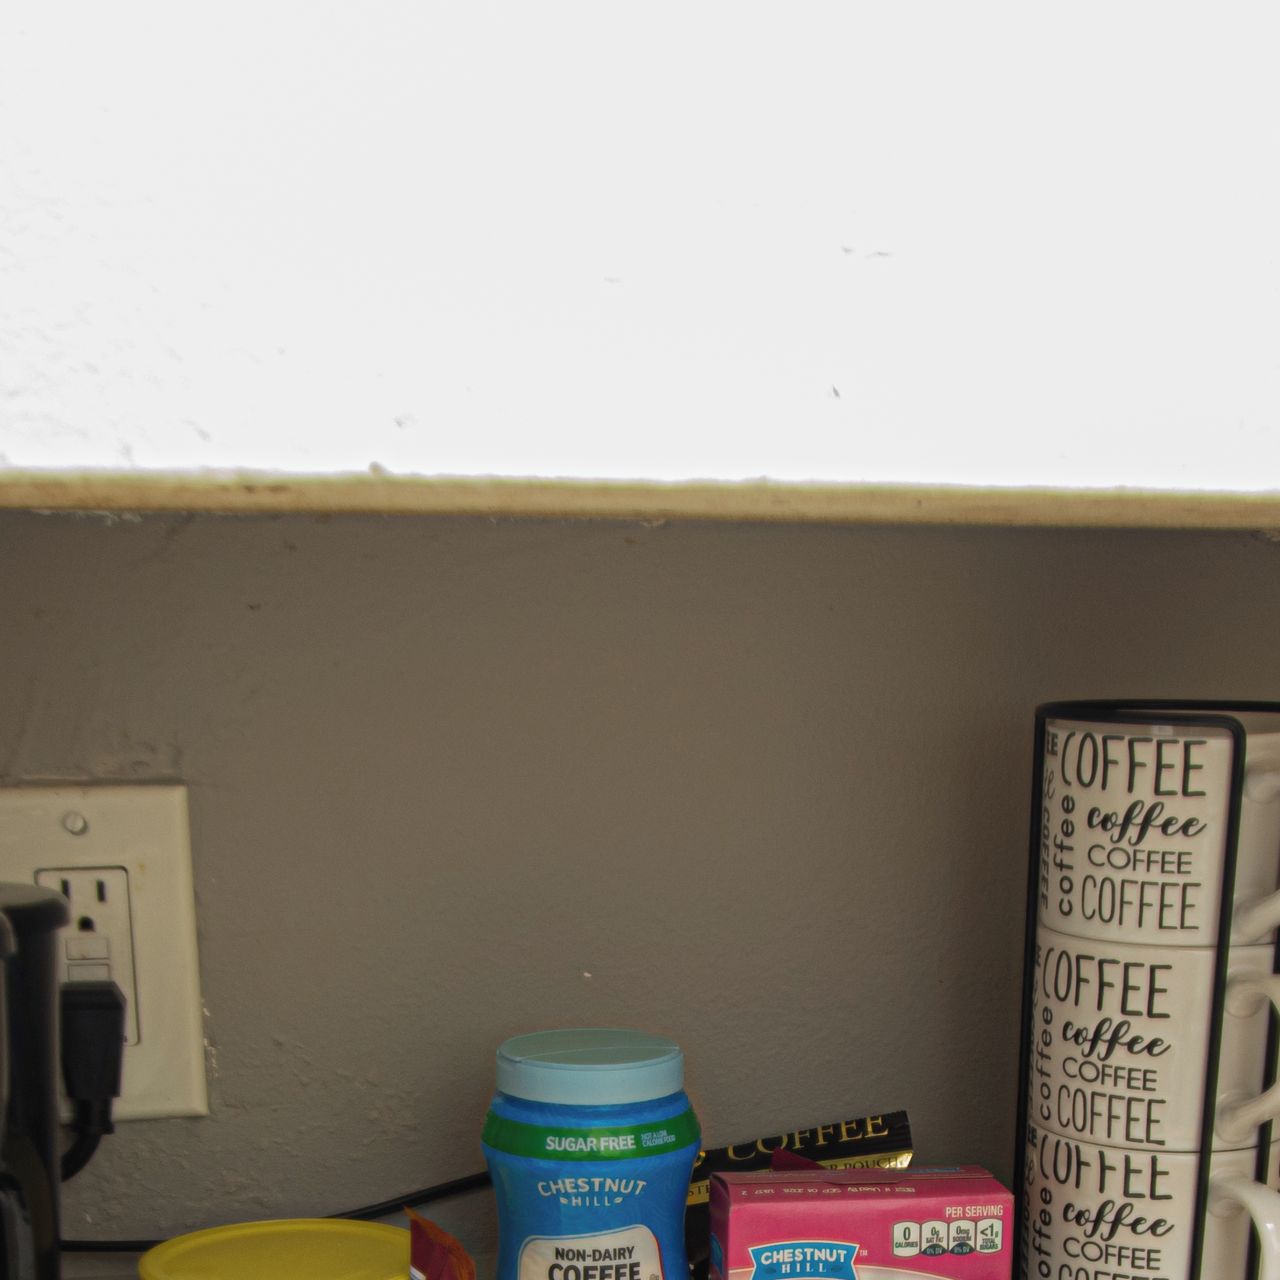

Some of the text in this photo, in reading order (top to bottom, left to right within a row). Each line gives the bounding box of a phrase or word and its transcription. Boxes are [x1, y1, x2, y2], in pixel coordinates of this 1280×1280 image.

[1061, 731, 1207, 797] COFFEE
[1087, 799, 1207, 846] coffee
[1054, 794, 1076, 917] coffee
[1087, 844, 1193, 875] COFFEE
[1081, 875, 1201, 930] COFFEE
[1043, 947, 1173, 1019] COFFEE
[1062, 1017, 1172, 1061] coffee
[1036, 1005, 1053, 1121] coffee
[1062, 1056, 1157, 1091] COFFEE
[1057, 1084, 1167, 1146] COFFEE
[546, 1135, 636, 1151] SUGAR FREE
[728, 1114, 889, 1161] COFFEE
[1040, 1134, 1173, 1201] COFFEE
[537, 1178, 648, 1197] CHESTNUT
[572, 1196, 610, 1207] HILL
[945, 1205, 1003, 1218] PER SERVING
[1062, 1199, 1174, 1242] coffee
[903, 1227, 911, 1240] 0
[555, 1246, 635, 1262] NON-DAIRY
[761, 1248, 847, 1264] CHESTNUT
[782, 1262, 828, 1274] HILL
[1063, 1237, 1161, 1271] COFFEE
